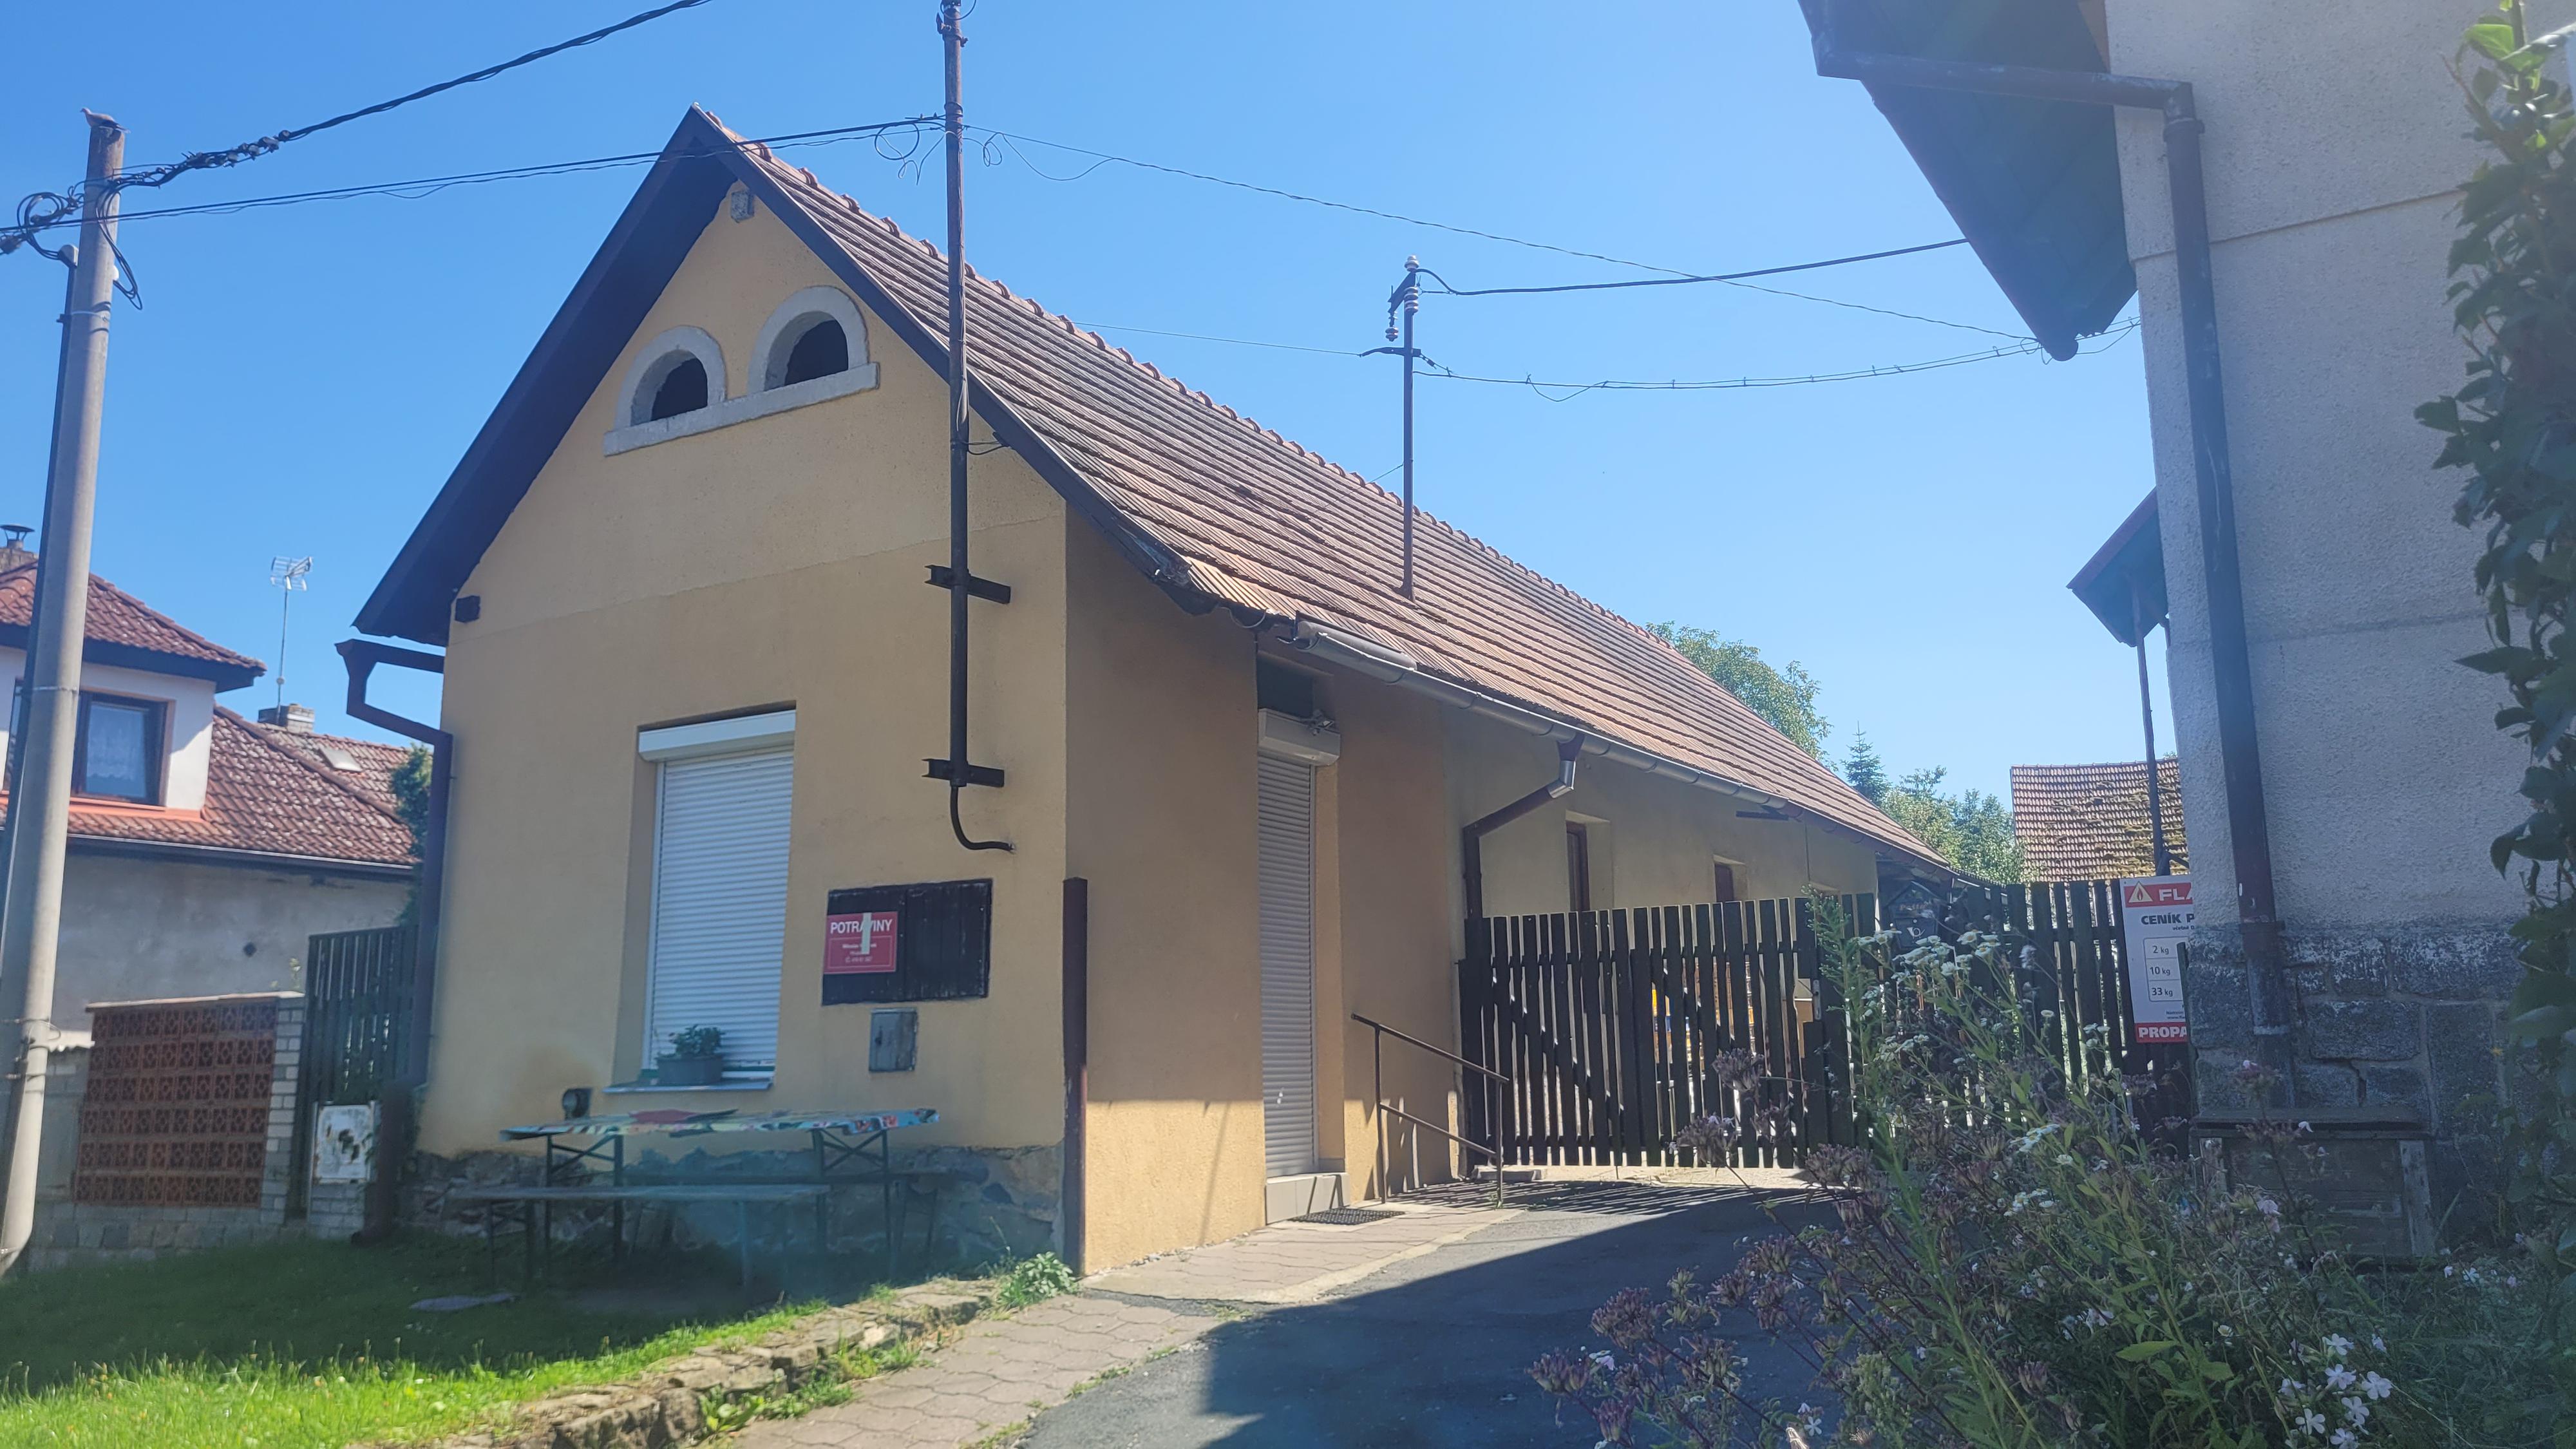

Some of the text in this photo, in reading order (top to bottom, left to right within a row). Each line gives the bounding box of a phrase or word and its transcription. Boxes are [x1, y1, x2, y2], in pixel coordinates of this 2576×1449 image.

[2141, 913, 2181, 925] CENÍK
[2150, 966, 2161, 975] 10
[2152, 987, 2163, 996] 33
[2139, 1027, 2187, 1037] PROPA
